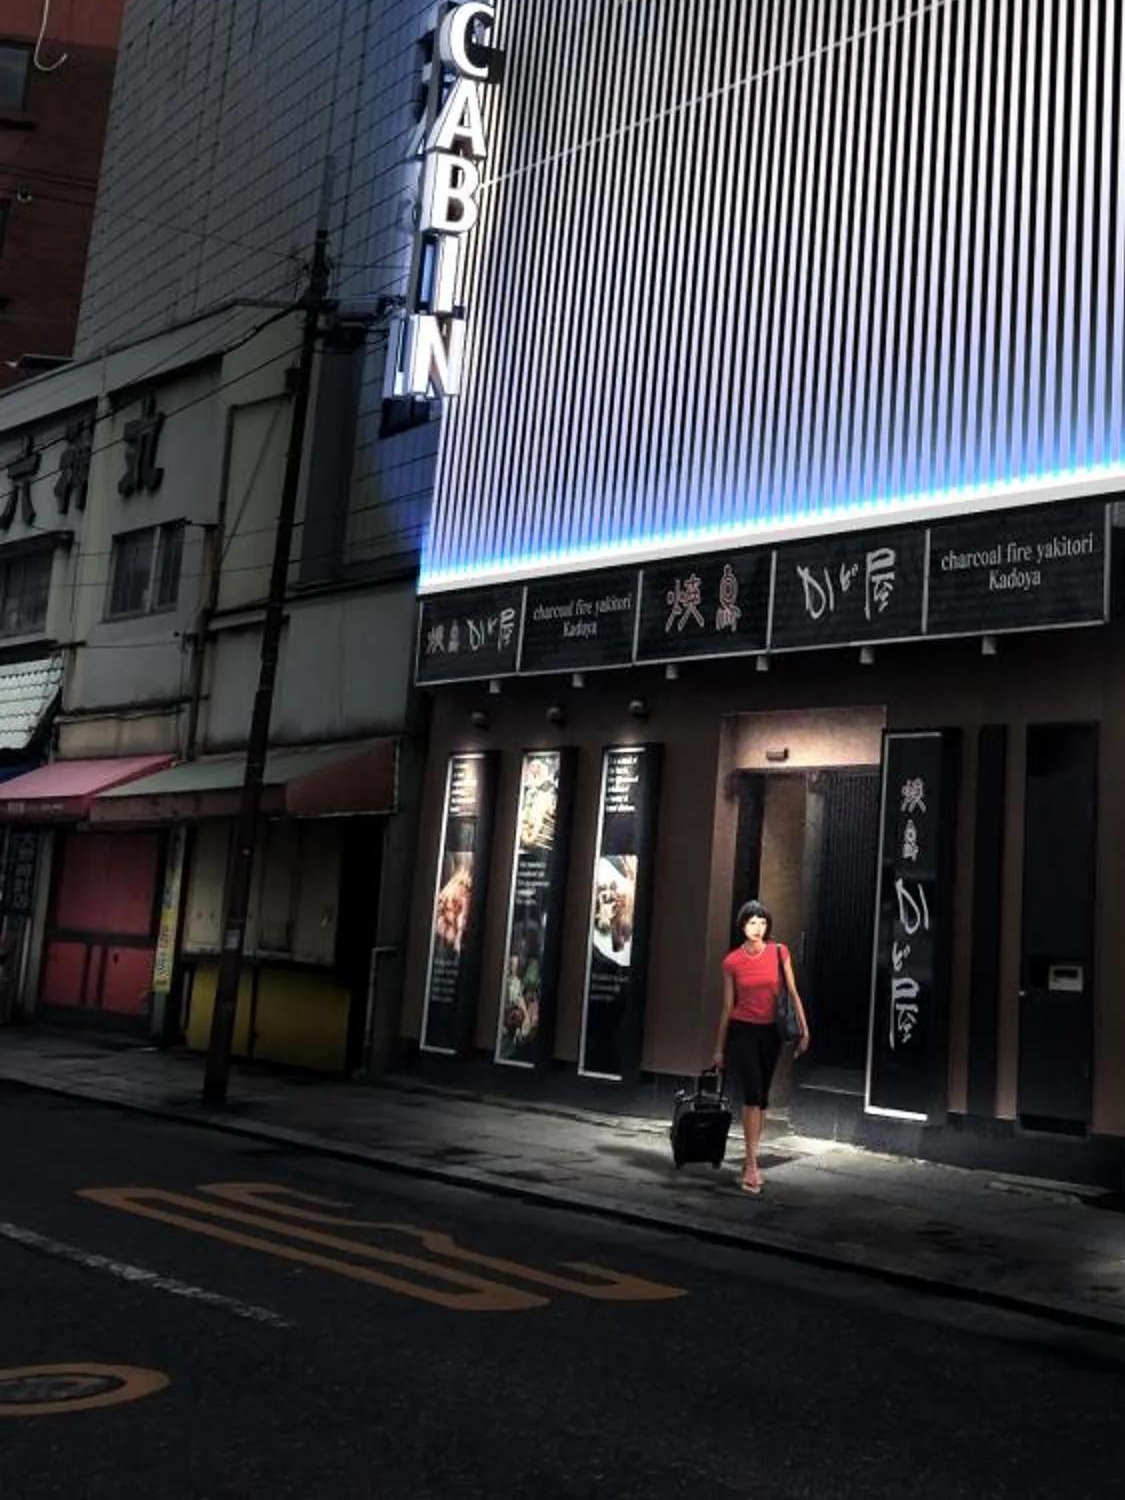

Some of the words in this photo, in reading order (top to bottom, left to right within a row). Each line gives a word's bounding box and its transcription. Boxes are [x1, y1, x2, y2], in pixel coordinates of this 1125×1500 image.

[408, 1, 496, 399] CABIN
[941, 544, 1002, 572] charcoal
[1007, 542, 1033, 564] fire
[1036, 532, 1094, 564] yakitori
[989, 567, 1041, 591] Kadoya
[532, 600, 574, 621] charcoal
[575, 598, 593, 616] fire
[594, 592, 633, 616] yakitori
[562, 620, 598, 639] Kadoya
